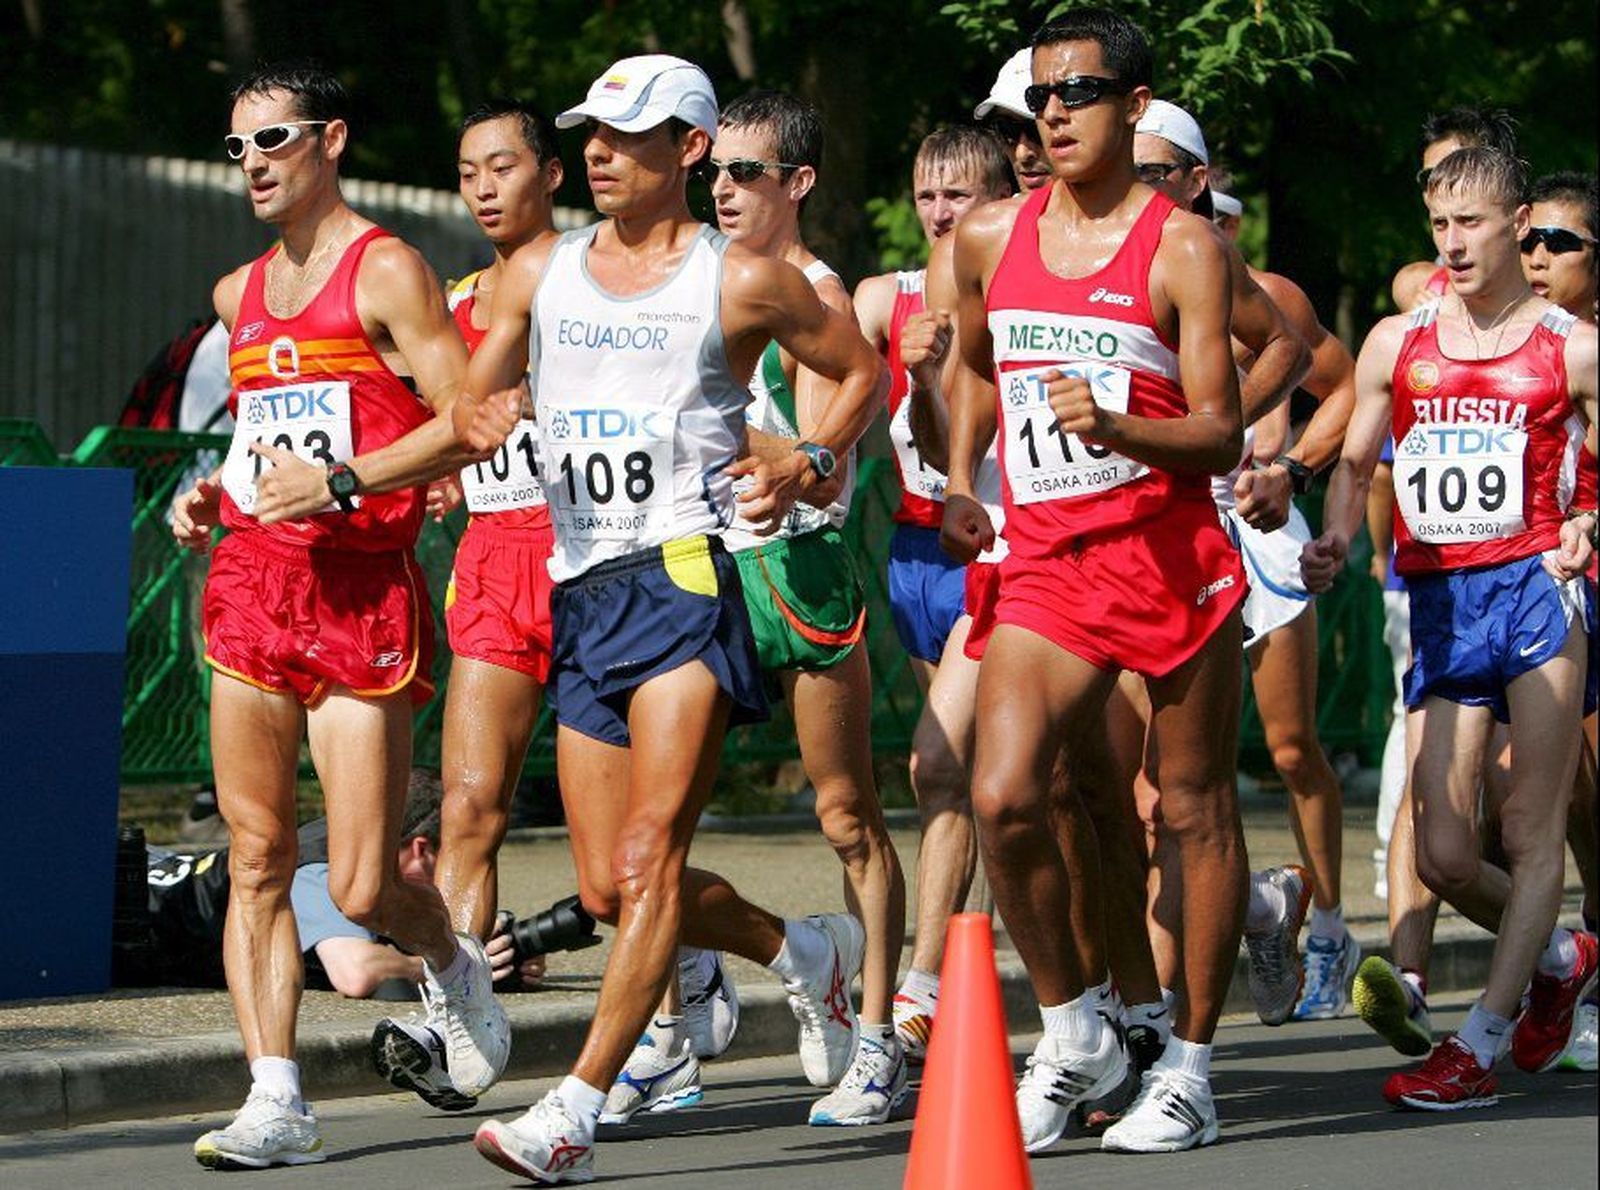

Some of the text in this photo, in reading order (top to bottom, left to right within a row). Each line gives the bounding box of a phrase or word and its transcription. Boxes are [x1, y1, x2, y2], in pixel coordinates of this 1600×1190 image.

[637, 311, 701, 324] marathon
[558, 319, 669, 351] ECUADOR
[1009, 324, 1119, 358] MEXICO
[1026, 367, 1116, 401] TK
[261, 387, 336, 421] TDK
[1412, 397, 1528, 432] RUSSIA
[570, 408, 662, 439] TDK
[1427, 428, 1515, 455] TDK
[560, 451, 655, 505] 108
[1031, 465, 1120, 493] OSAKA 2007
[1407, 464, 1506, 514] 109
[473, 486, 541, 506] OSAKA 2007
[617, 513, 647, 530] 2007
[1418, 522, 1501, 537] OSAKA 2007
